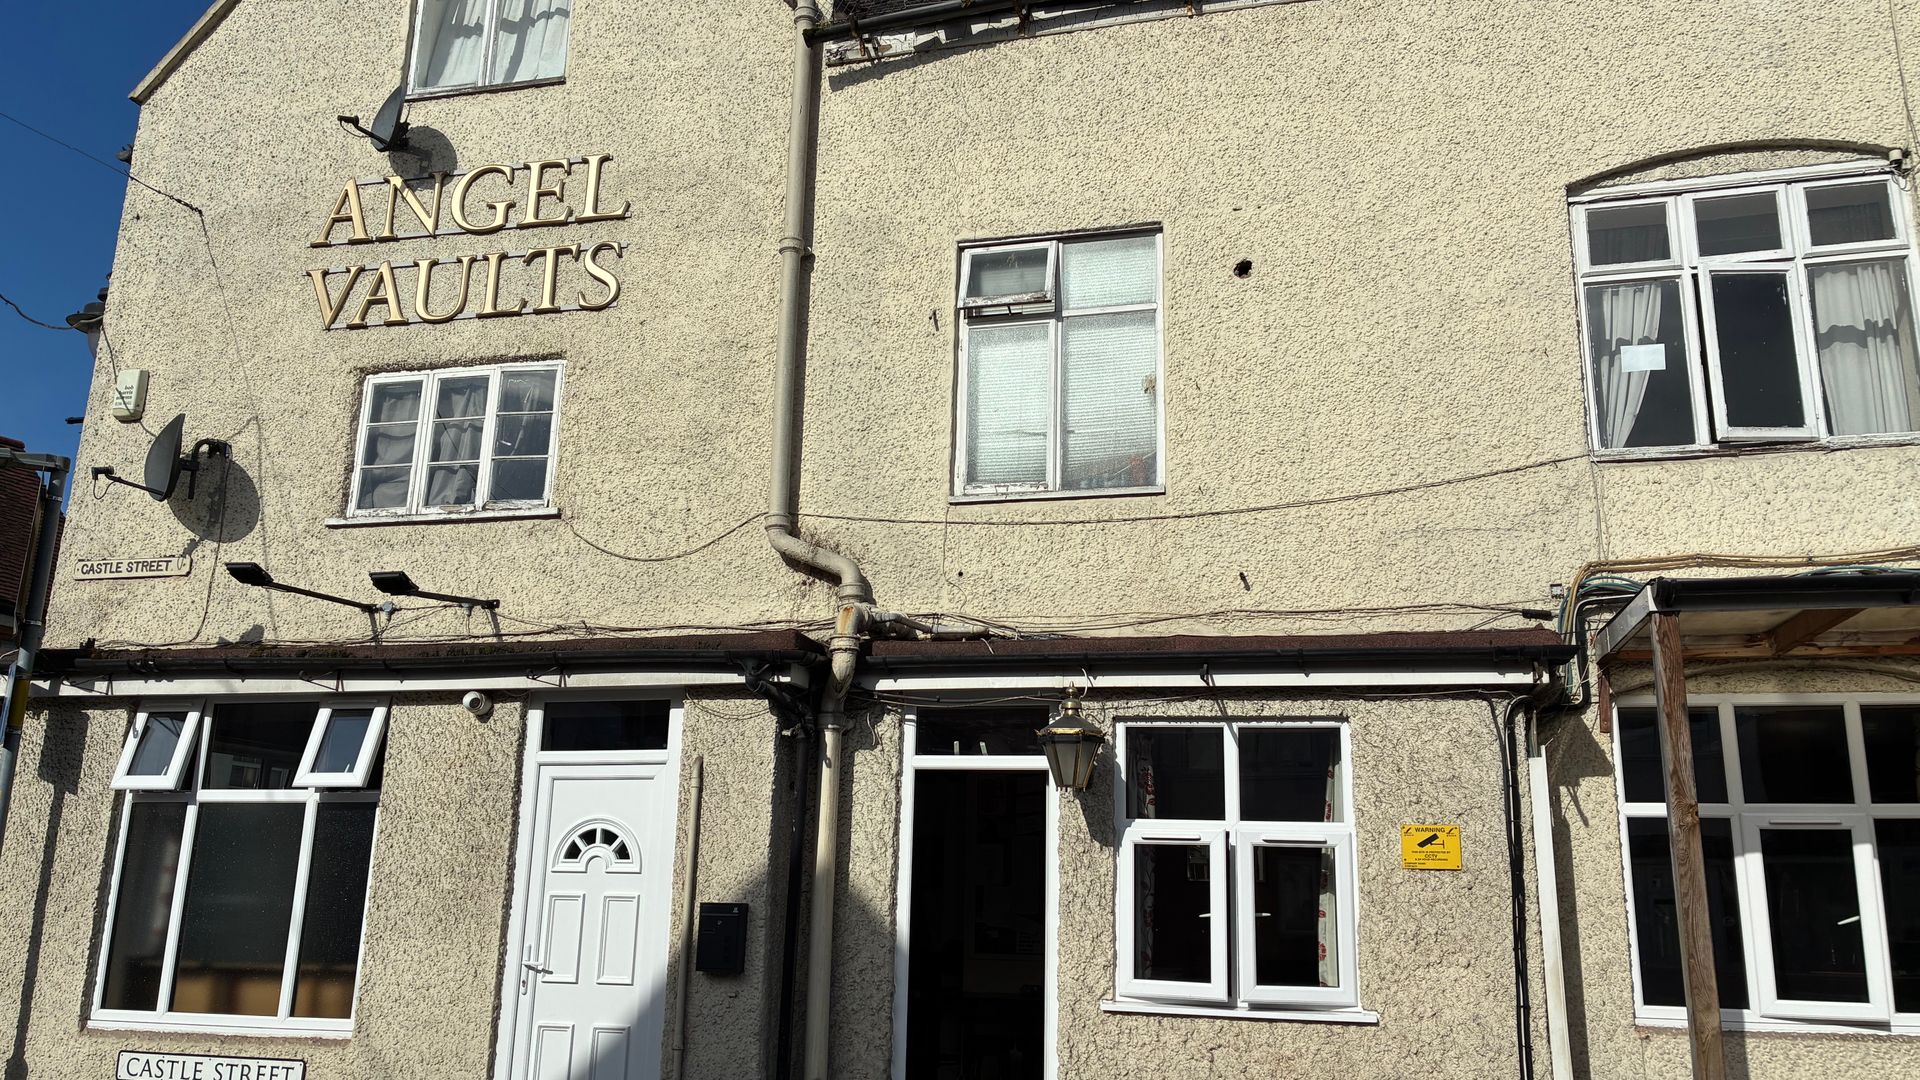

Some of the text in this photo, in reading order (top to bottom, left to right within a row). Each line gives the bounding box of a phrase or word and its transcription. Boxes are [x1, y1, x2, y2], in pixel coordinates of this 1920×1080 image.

[310, 153, 631, 247] ANGEL
[306, 240, 623, 330] VAULTS
[81, 560, 172, 575] CASTLE STREET
[126, 1057, 295, 1080] CASTLE STREET
